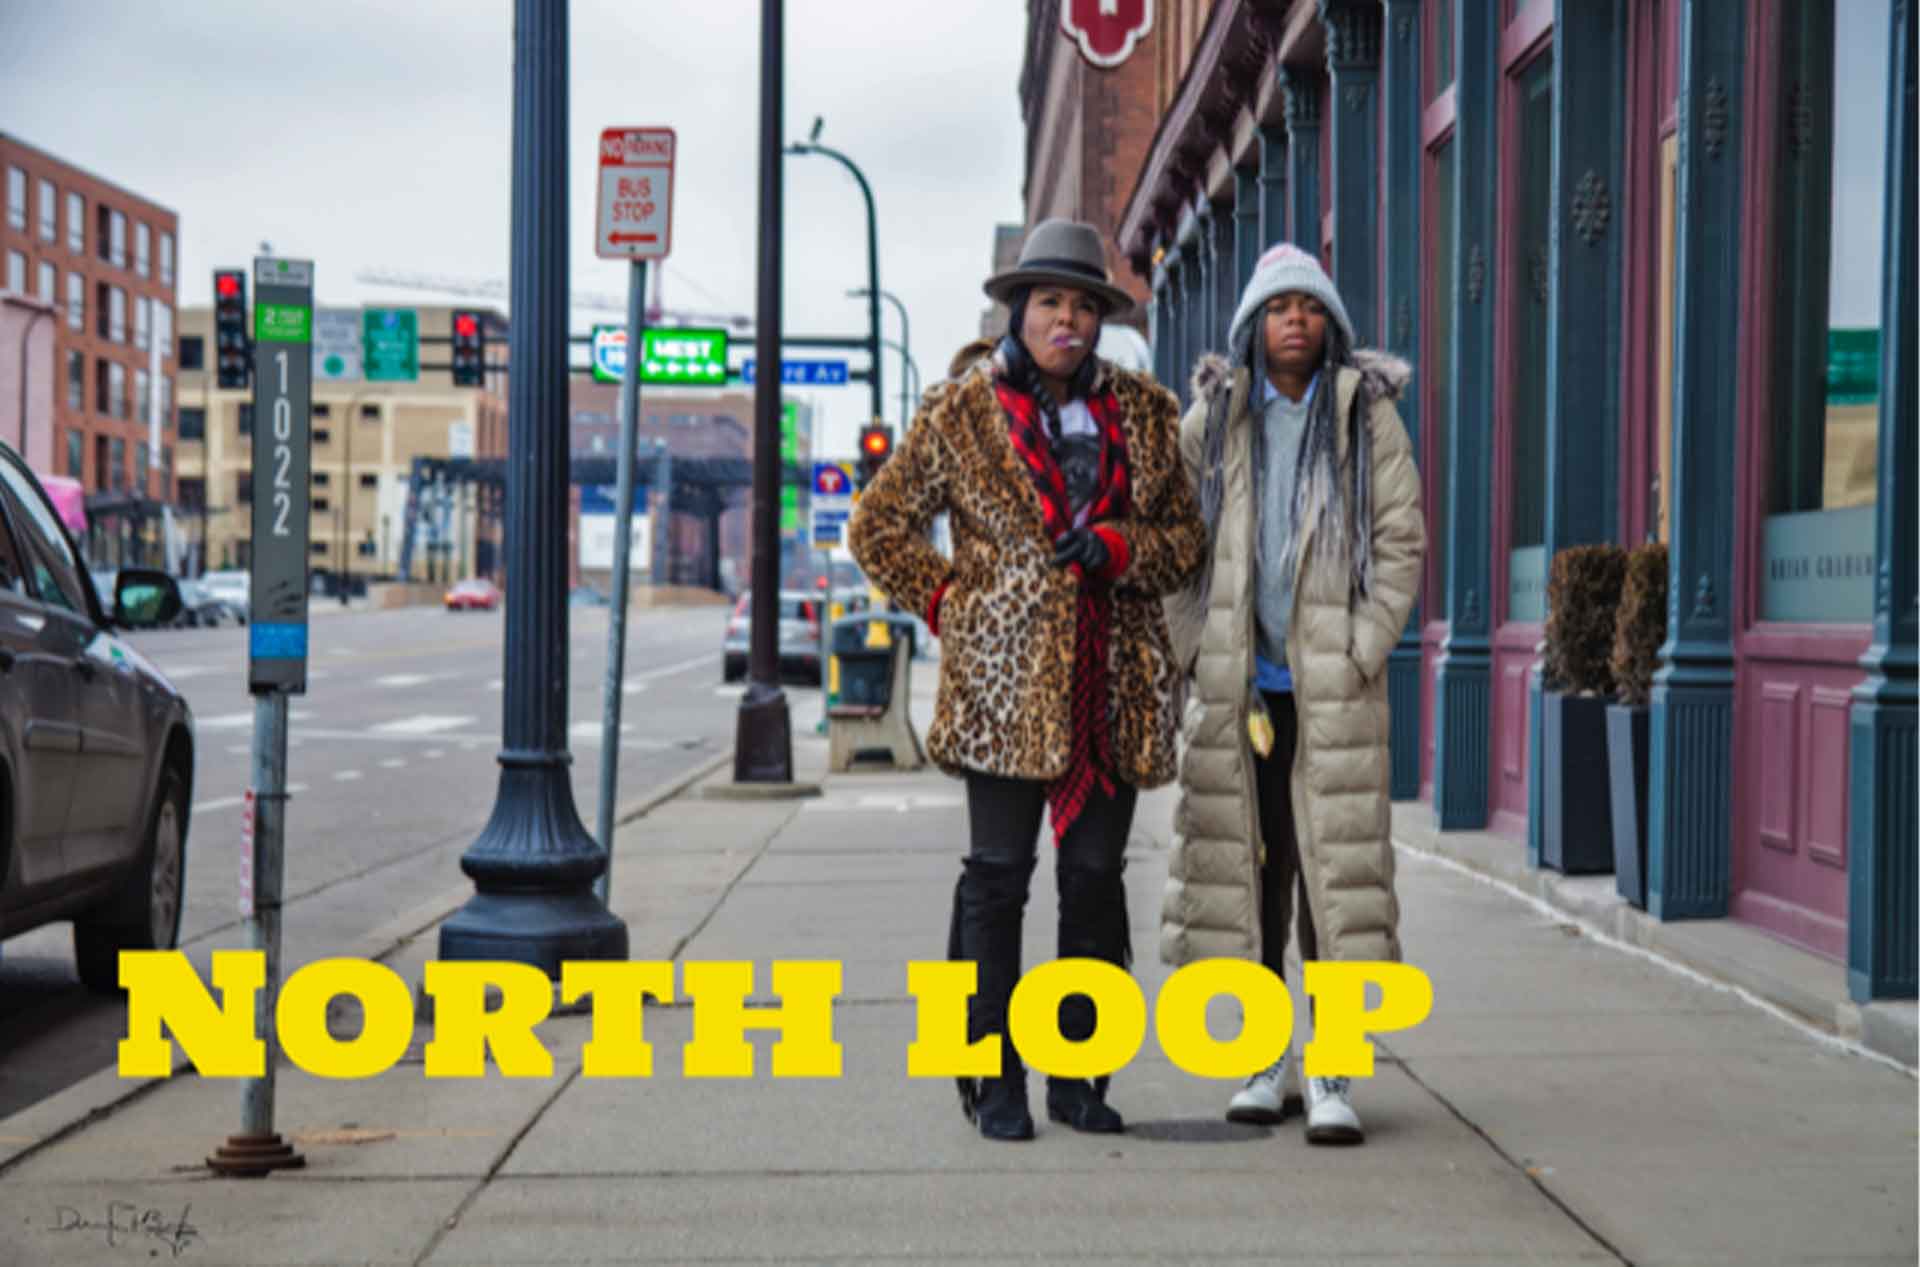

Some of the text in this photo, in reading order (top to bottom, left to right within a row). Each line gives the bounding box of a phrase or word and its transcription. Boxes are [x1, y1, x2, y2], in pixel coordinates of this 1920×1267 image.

[617, 177, 650, 198] BUS
[612, 201, 656, 223] STOP
[653, 339, 711, 358] WEST
[272, 350, 291, 536] 1022
